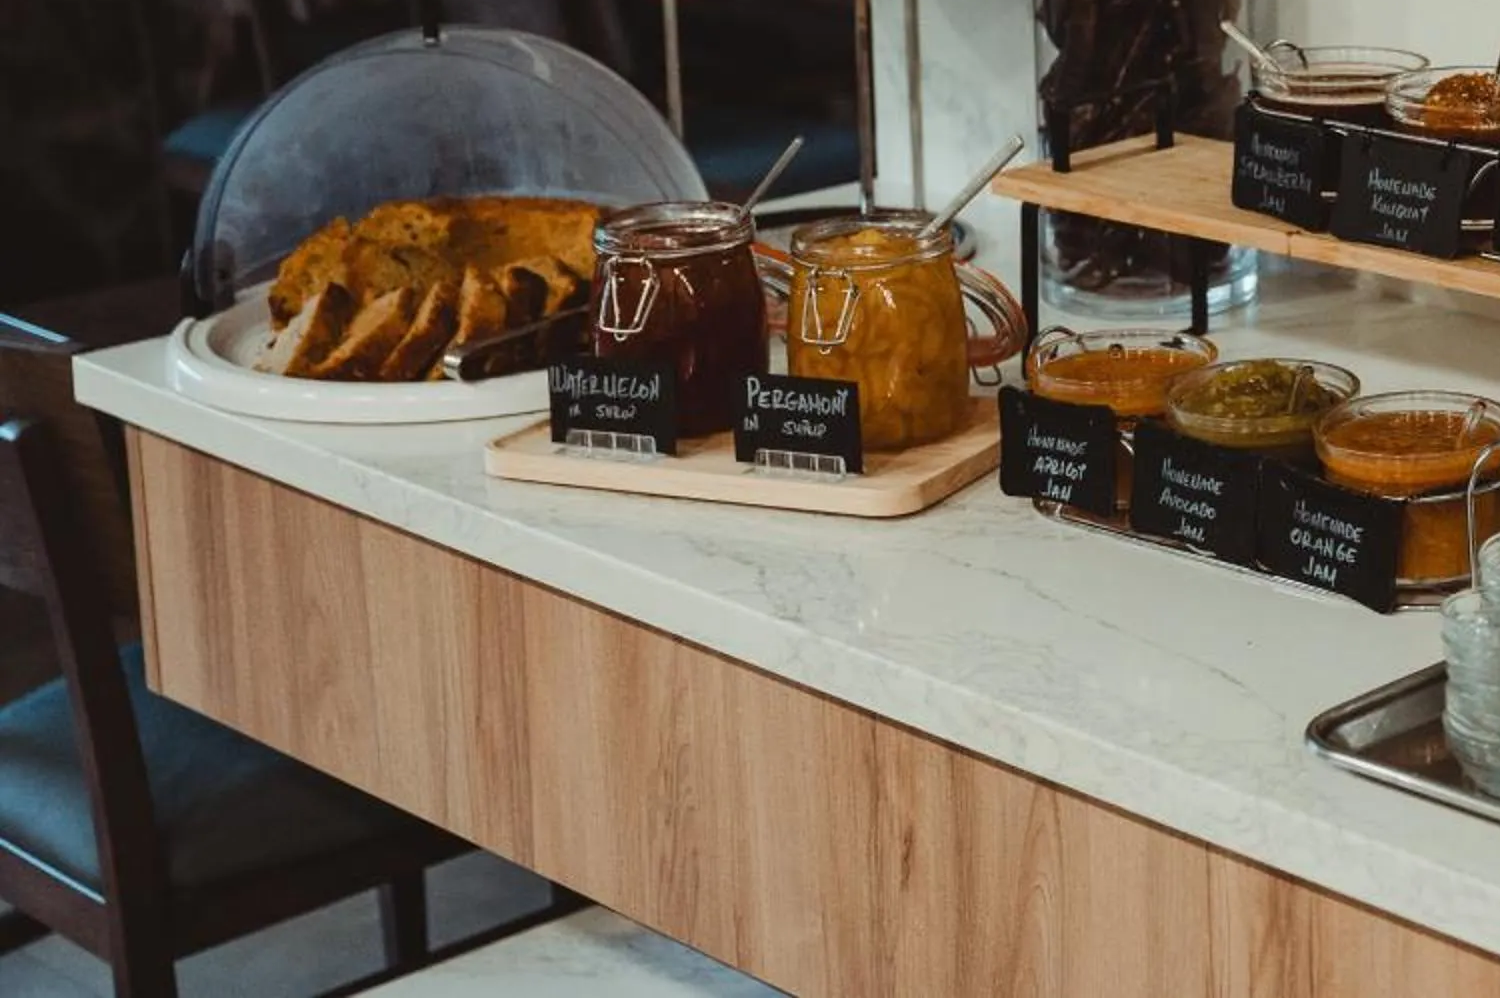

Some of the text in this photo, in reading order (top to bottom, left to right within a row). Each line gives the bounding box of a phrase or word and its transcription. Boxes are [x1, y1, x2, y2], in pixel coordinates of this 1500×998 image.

[1367, 167, 1438, 201] HOMEMADE
[1376, 222, 1408, 242] JAM
[550, 363, 660, 401] WATERMELON
[747, 377, 849, 416] PERGAMONT
[744, 413, 759, 431] IN
[1027, 423, 1088, 456] HOMEMADE
[1041, 478, 1072, 501] JAM
[1161, 457, 1224, 495] HOMEMADE
[1159, 487, 1216, 520] AVOCADO
[1173, 516, 1205, 542] JAM
[1294, 499, 1364, 543] HOMEMADE
[1290, 527, 1358, 563] ORANGE
[1302, 556, 1337, 587] JAM
